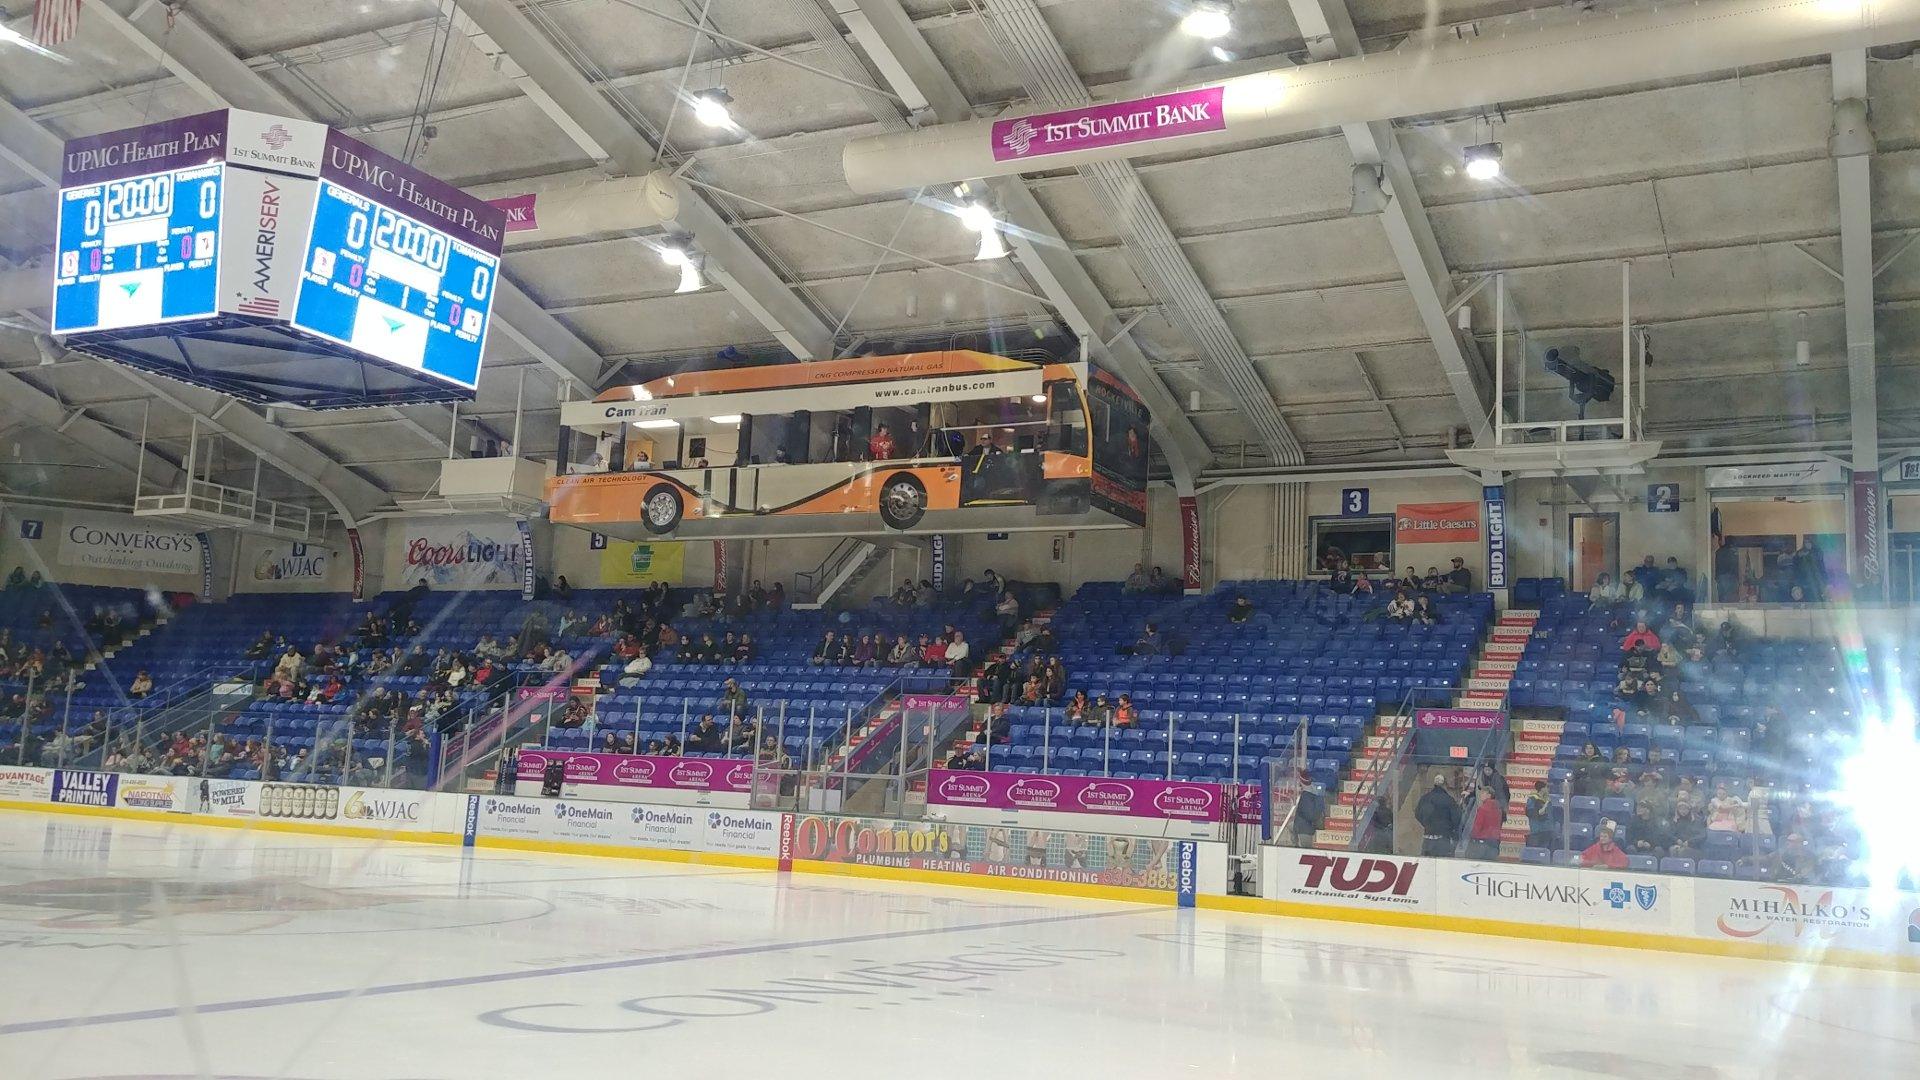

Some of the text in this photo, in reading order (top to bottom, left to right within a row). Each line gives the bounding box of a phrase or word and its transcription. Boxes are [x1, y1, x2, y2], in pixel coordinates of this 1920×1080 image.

[1044, 102, 1210, 143] 1ST SUMMIT BANK
[67, 131, 222, 173] UPMC HEALTH PLAN
[232, 147, 316, 169] 1ST SUMMIT BANK
[199, 181, 216, 218] 0
[327, 186, 371, 212] GENERALS
[331, 145, 499, 242] UPMC HEALTH PLAN
[84, 200, 100, 236] 0
[506, 206, 529, 223] NK
[253, 179, 281, 294] AMERISERV
[346, 211, 367, 249] 0
[349, 263, 364, 288] 0
[471, 265, 489, 301] 0
[449, 303, 461, 326] 0
[833, 368, 886, 378] COMPRESSED
[887, 365, 924, 373] NATURAL
[598, 475, 647, 483] TECHNOLOGY
[1350, 490, 1361, 513] 3
[1656, 486, 1671, 509] 2
[29, 522, 37, 538] 7
[1413, 518, 1477, 530] Little Caesars
[1864, 487, 1879, 580] Budweiser
[70, 526, 192, 552] CONVERGYS
[1187, 509, 1199, 584] Budweiser
[1489, 502, 1504, 586] BUD LIGHT
[407, 537, 519, 566] Coors LIGHT
[281, 557, 324, 576] WJAC
[522, 531, 534, 595] BUD LIGHT
[932, 534, 944, 593] BUD LIGH
[1438, 715, 1450, 723] 1ST
[1450, 715, 1479, 724] SUMMIT
[62, 771, 110, 792] VALLEY
[212, 787, 245, 798] POWERED
[958, 784, 984, 792] SUMMIT
[1016, 787, 1053, 796] 1ST SUMMIT
[58, 789, 108, 806] PRINTING
[127, 790, 172, 800] NAPOTNIK
[220, 795, 245, 805] MILK
[1099, 791, 1127, 800] SUMMIT
[1176, 796, 1205, 805] SUMMIT
[374, 800, 419, 820] WJAC
[466, 795, 477, 836] Reebok
[497, 814, 526, 824] Financial
[498, 802, 541, 815] OneMain
[568, 806, 613, 820] OneMain
[645, 811, 693, 825] OneMain
[567, 819, 597, 828] Financial
[644, 823, 677, 834] Financial
[723, 816, 772, 830] OneMain
[722, 829, 755, 840] Financial
[781, 814, 793, 860] Reebok
[797, 815, 949, 856] O'Connor's
[856, 854, 911, 868] PLUMBING
[922, 859, 971, 873] HEATING
[986, 865, 1006, 876] AIR
[1011, 866, 1099, 884] CONDITIONING
[1181, 842, 1194, 894] Reebok
[1298, 854, 1419, 896] TUDI
[1290, 888, 1419, 905] Mechanical Systems
[1475, 875, 1592, 906] HIGHMARK
[1730, 898, 1870, 920] MIHALKO'S
[1803, 918, 1869, 928] RESTORATION
